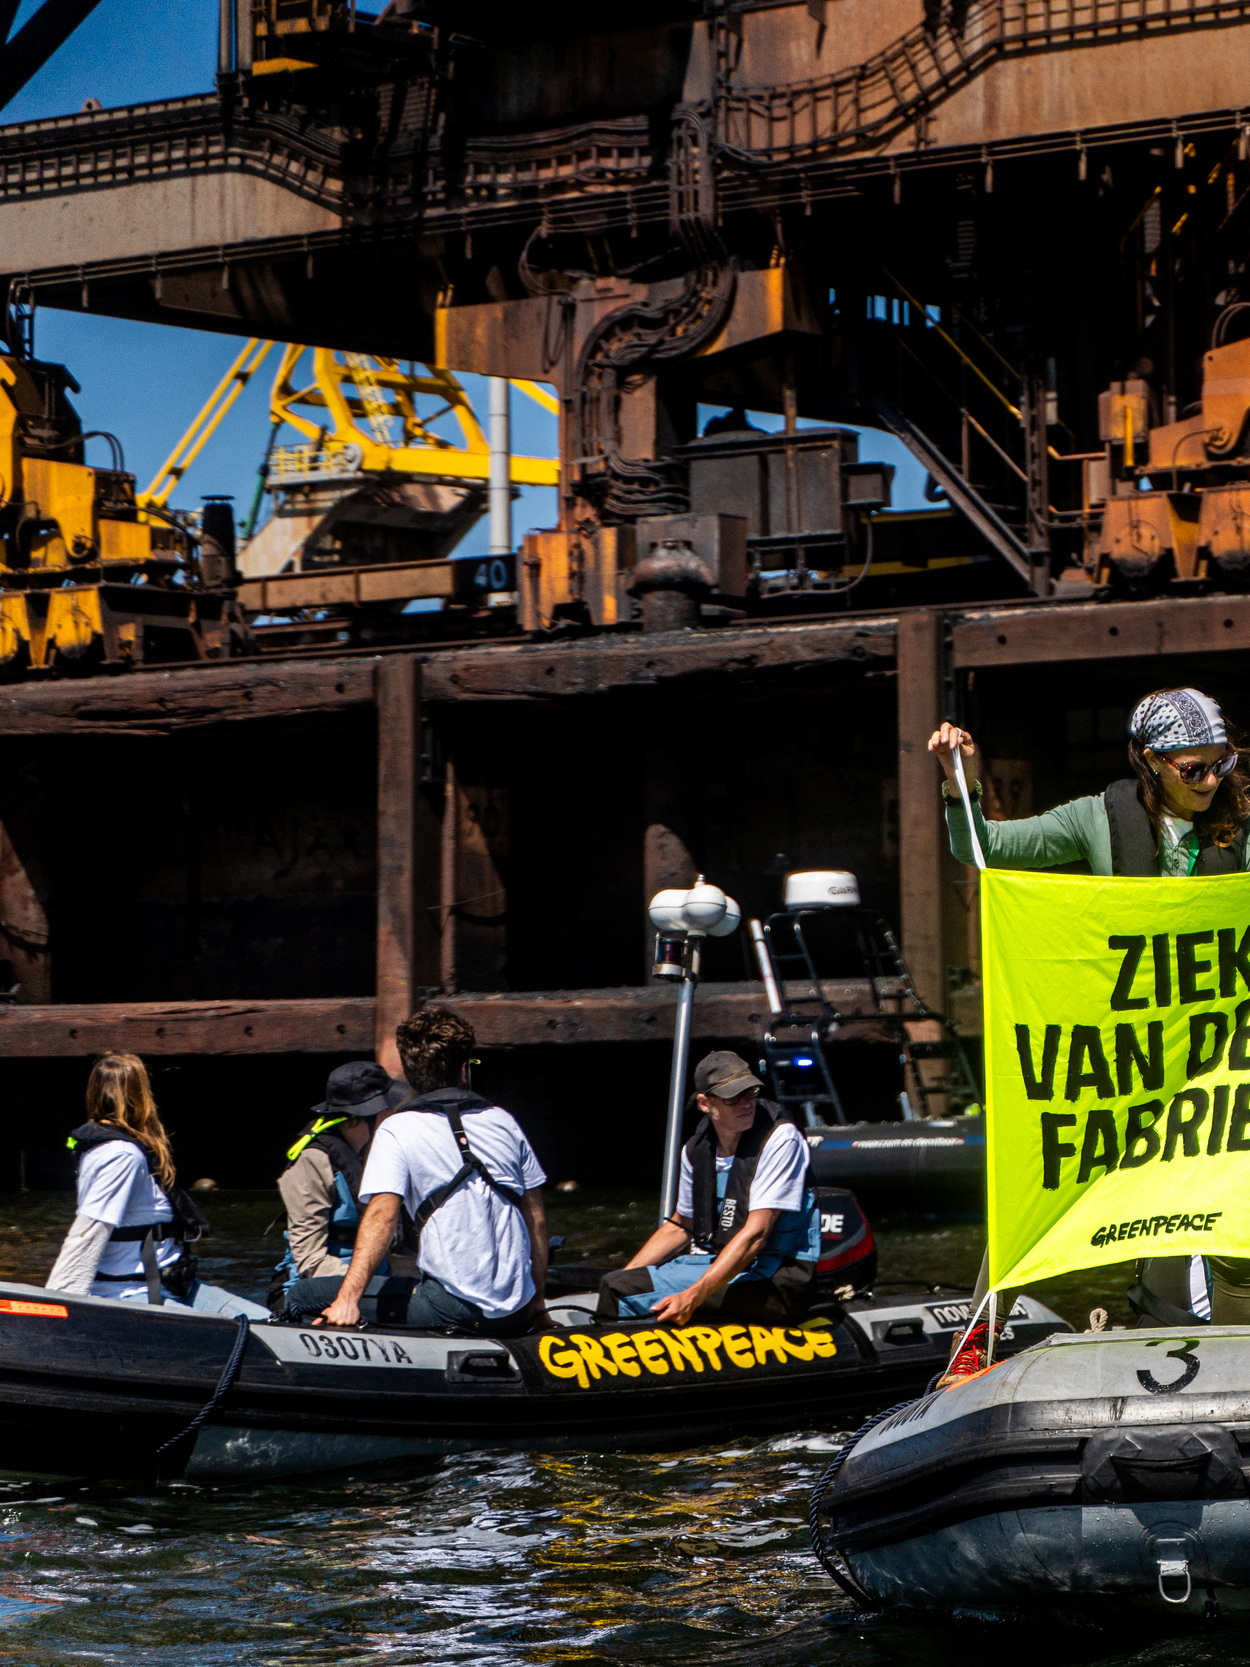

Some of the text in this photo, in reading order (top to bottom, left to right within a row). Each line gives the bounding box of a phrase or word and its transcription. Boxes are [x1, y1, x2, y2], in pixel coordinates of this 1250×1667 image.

[1015, 1020, 1165, 1101] VAN
[721, 1198, 737, 1228] BESTO
[1091, 1212, 1222, 1248] GREENPEACE
[539, 1317, 837, 1388] GREENPEACE
[1136, 1338, 1200, 1396] 3
